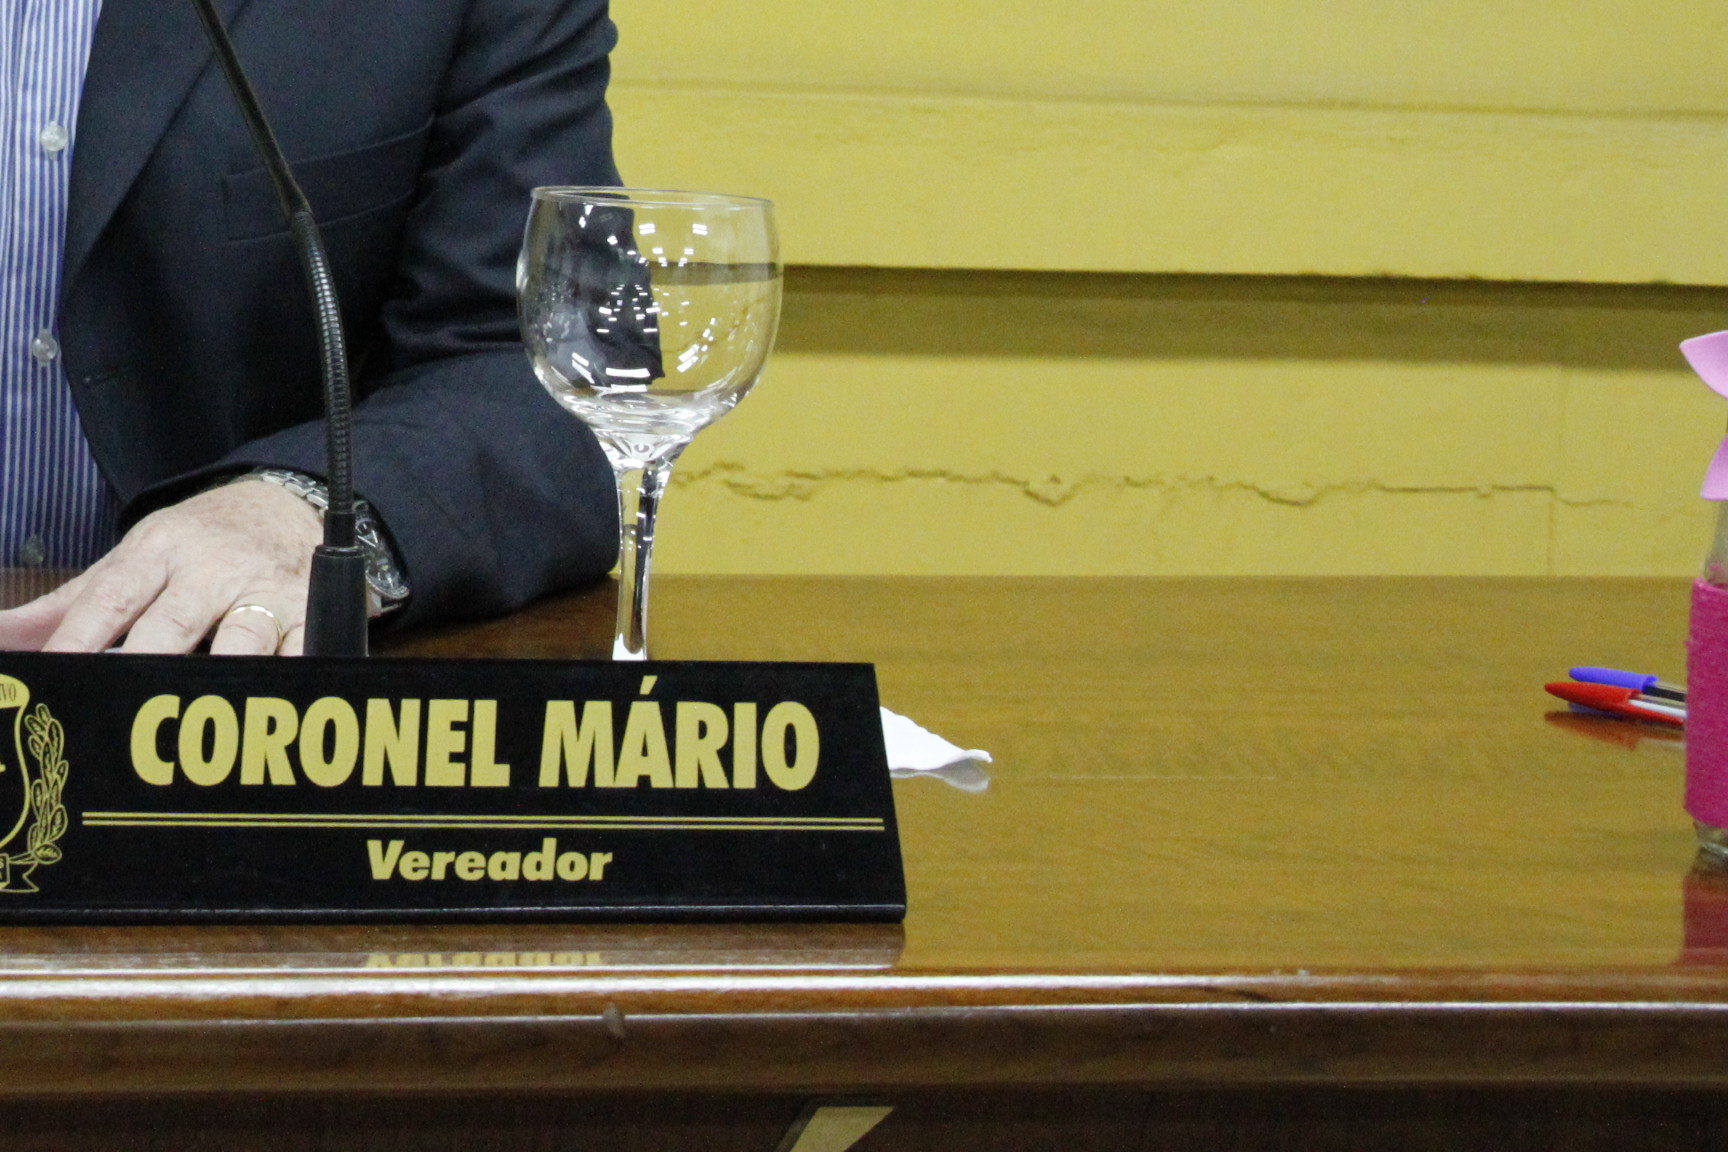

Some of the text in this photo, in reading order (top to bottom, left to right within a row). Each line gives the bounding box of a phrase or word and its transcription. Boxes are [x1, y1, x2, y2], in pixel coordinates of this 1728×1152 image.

[130, 675, 820, 791] CORONEL MÁRIO
[366, 837, 613, 882] Vereador
